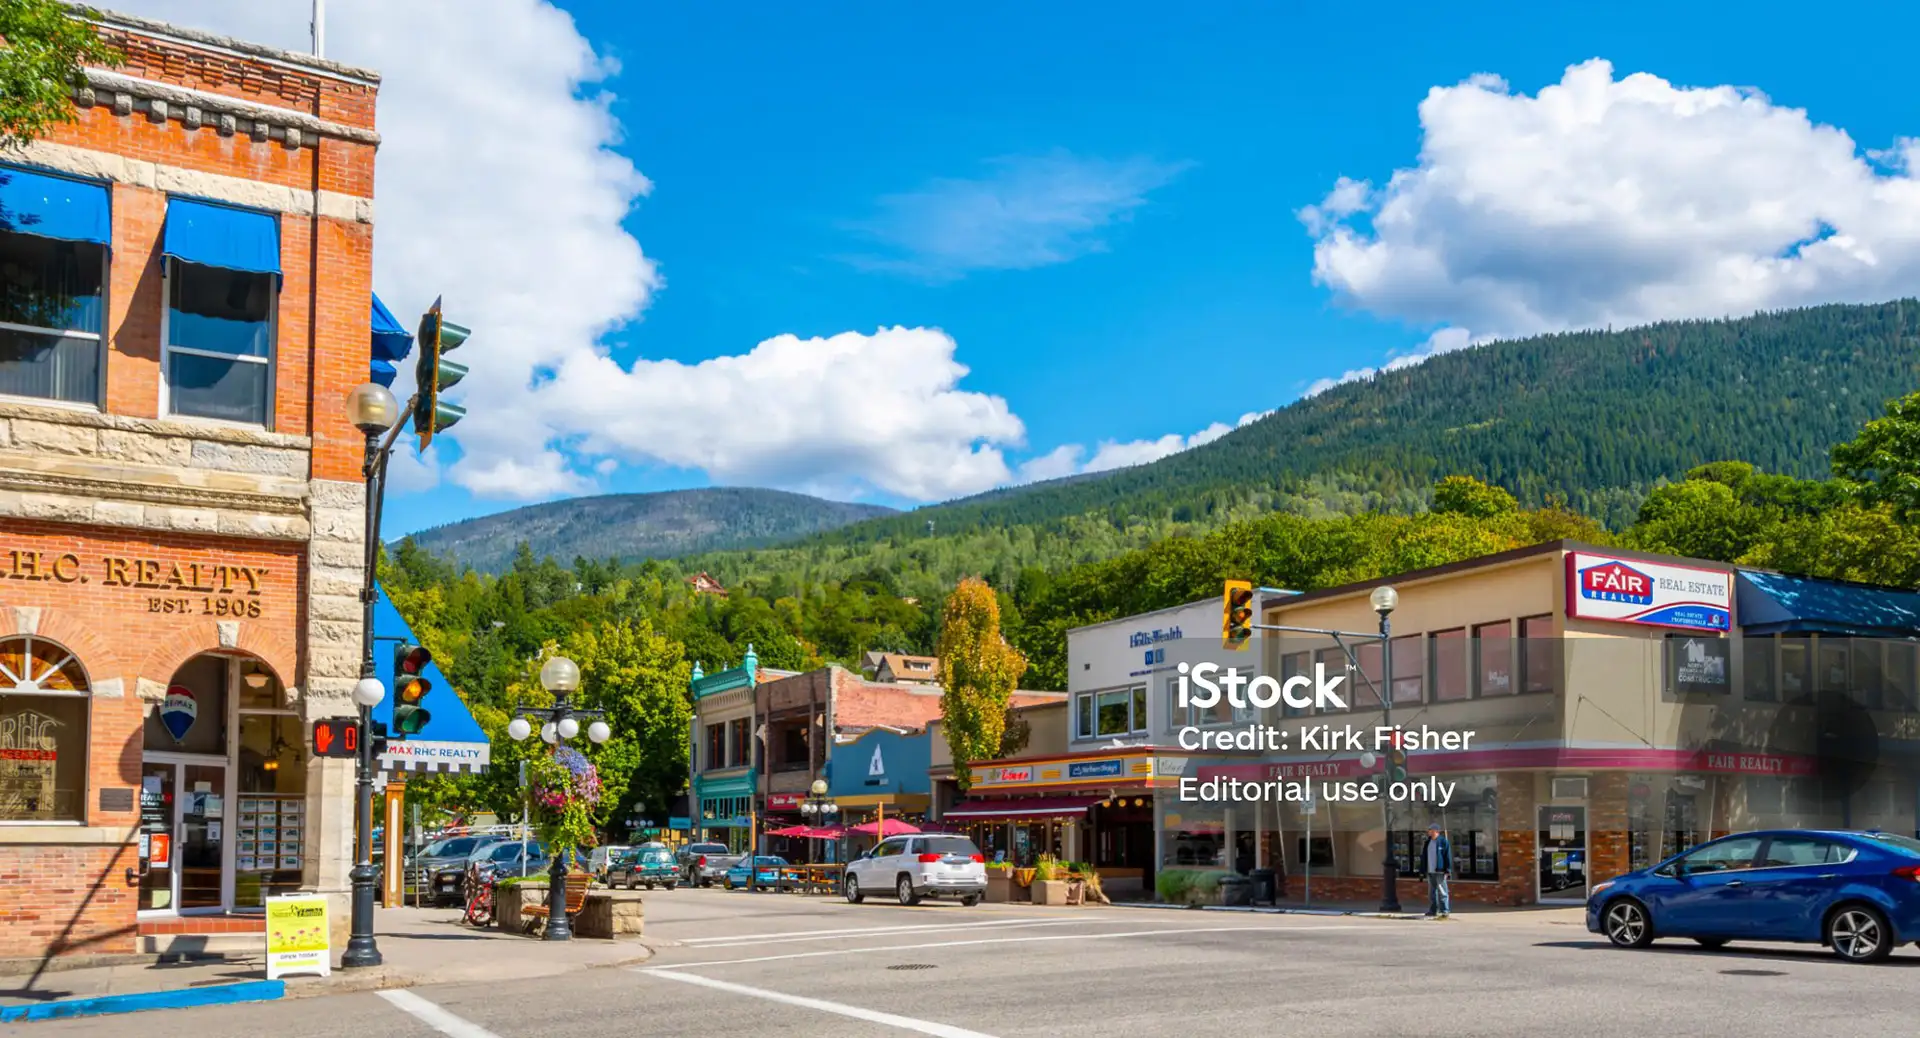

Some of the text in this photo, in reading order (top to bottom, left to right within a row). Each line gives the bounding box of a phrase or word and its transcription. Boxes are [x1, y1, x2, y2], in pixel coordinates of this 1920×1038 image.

[103, 557, 269, 595] REALTY
[1591, 571, 1644, 592] FAIR
[1659, 577, 1725, 597] REAL ESTATE
[1591, 591, 1645, 603] REALTY
[147, 596, 261, 619] EST. 1908
[414, 747, 437, 756] RHC
[439, 748, 481, 758] REALTY
[1269, 763, 1341, 777] FAIR REALTY
[1708, 755, 1736, 769] FAIR
[1740, 756, 1784, 771] REALTY
